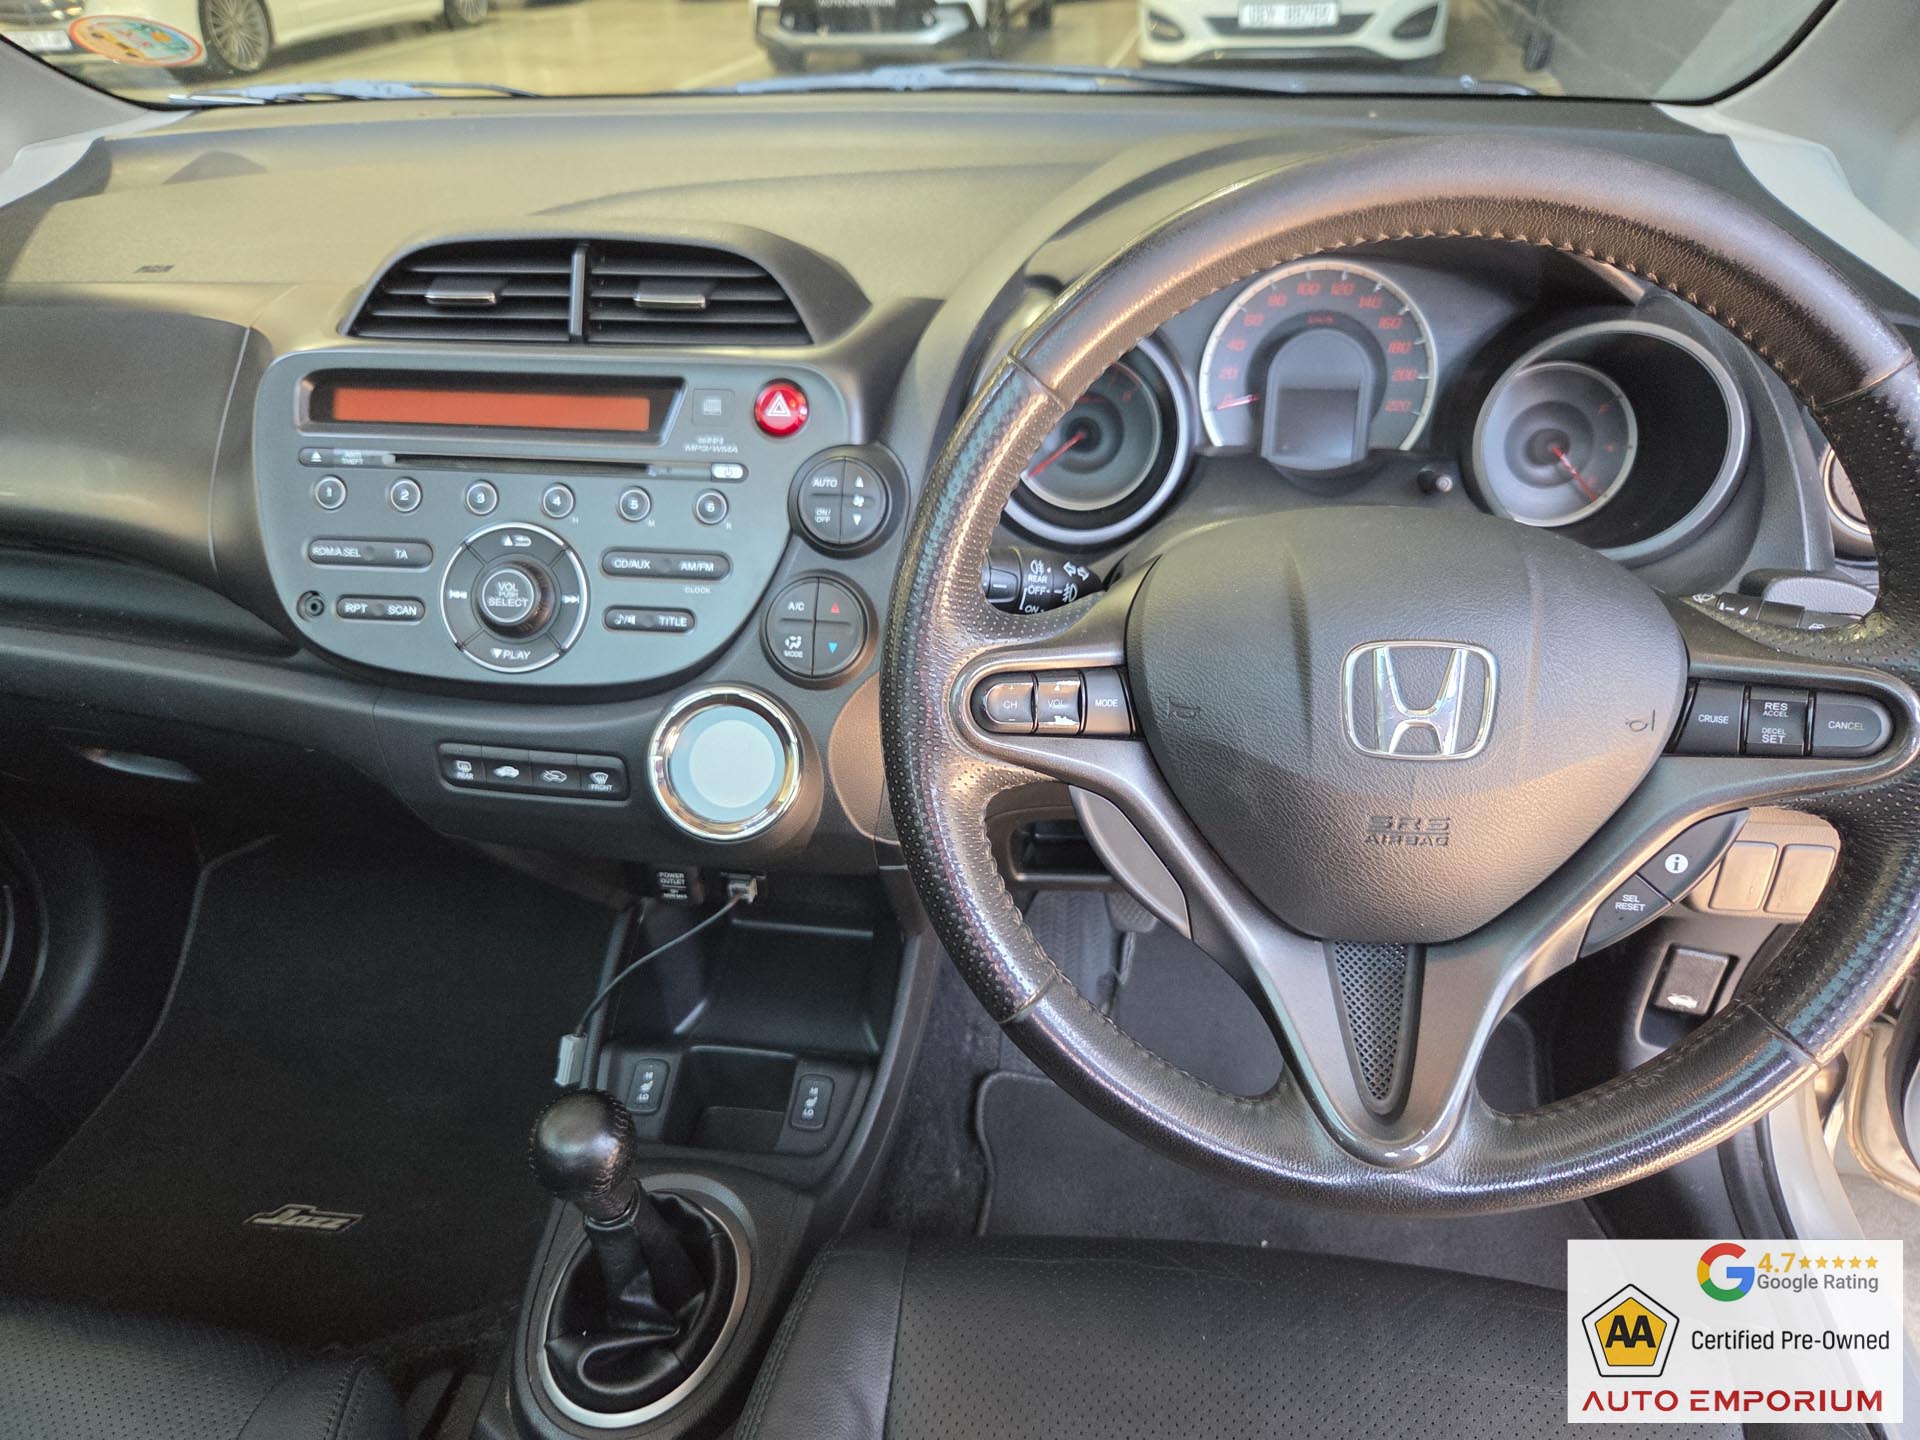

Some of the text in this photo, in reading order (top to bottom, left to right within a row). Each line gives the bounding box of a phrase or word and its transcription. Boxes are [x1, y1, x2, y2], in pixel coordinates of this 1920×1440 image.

[813, 478, 838, 488] AUTO
[400, 490, 410, 500] 2
[476, 492, 485, 503] 3
[552, 496, 562, 506] 4
[630, 500, 639, 509] 5
[706, 502, 715, 512] 6
[394, 549, 408, 559] TA
[614, 559, 650, 570] CD/AUX
[680, 562, 714, 572] AM/FM
[1028, 573, 1048, 584] REAR
[498, 582, 518, 592] VOL
[685, 586, 711, 594] CLOCK
[1028, 585, 1047, 595] OFF
[488, 598, 528, 607] SELECT
[787, 601, 805, 612] A/C
[345, 603, 367, 613] RPT
[387, 605, 417, 615] SCAN
[1025, 605, 1040, 614] ON
[659, 616, 688, 626] TITLE
[503, 650, 531, 659] PLAY
[784, 649, 803, 658] MODE
[1003, 700, 1018, 709] CH
[1048, 700, 1065, 708] VOL
[1764, 701, 1788, 711] RES
[1698, 714, 1729, 724] CRUISE
[1762, 710, 1789, 718] ACCEL
[1828, 721, 1864, 731] CANCEL
[1762, 728, 1787, 736] DECEL
[1762, 734, 1785, 744] SET
[456, 771, 474, 780] REAR
[591, 783, 613, 792] FRONT
[1364, 834, 1449, 846] AIRBAG
[659, 871, 685, 879] POWER
[1622, 894, 1641, 903] SEL
[1615, 902, 1645, 912] RESET
